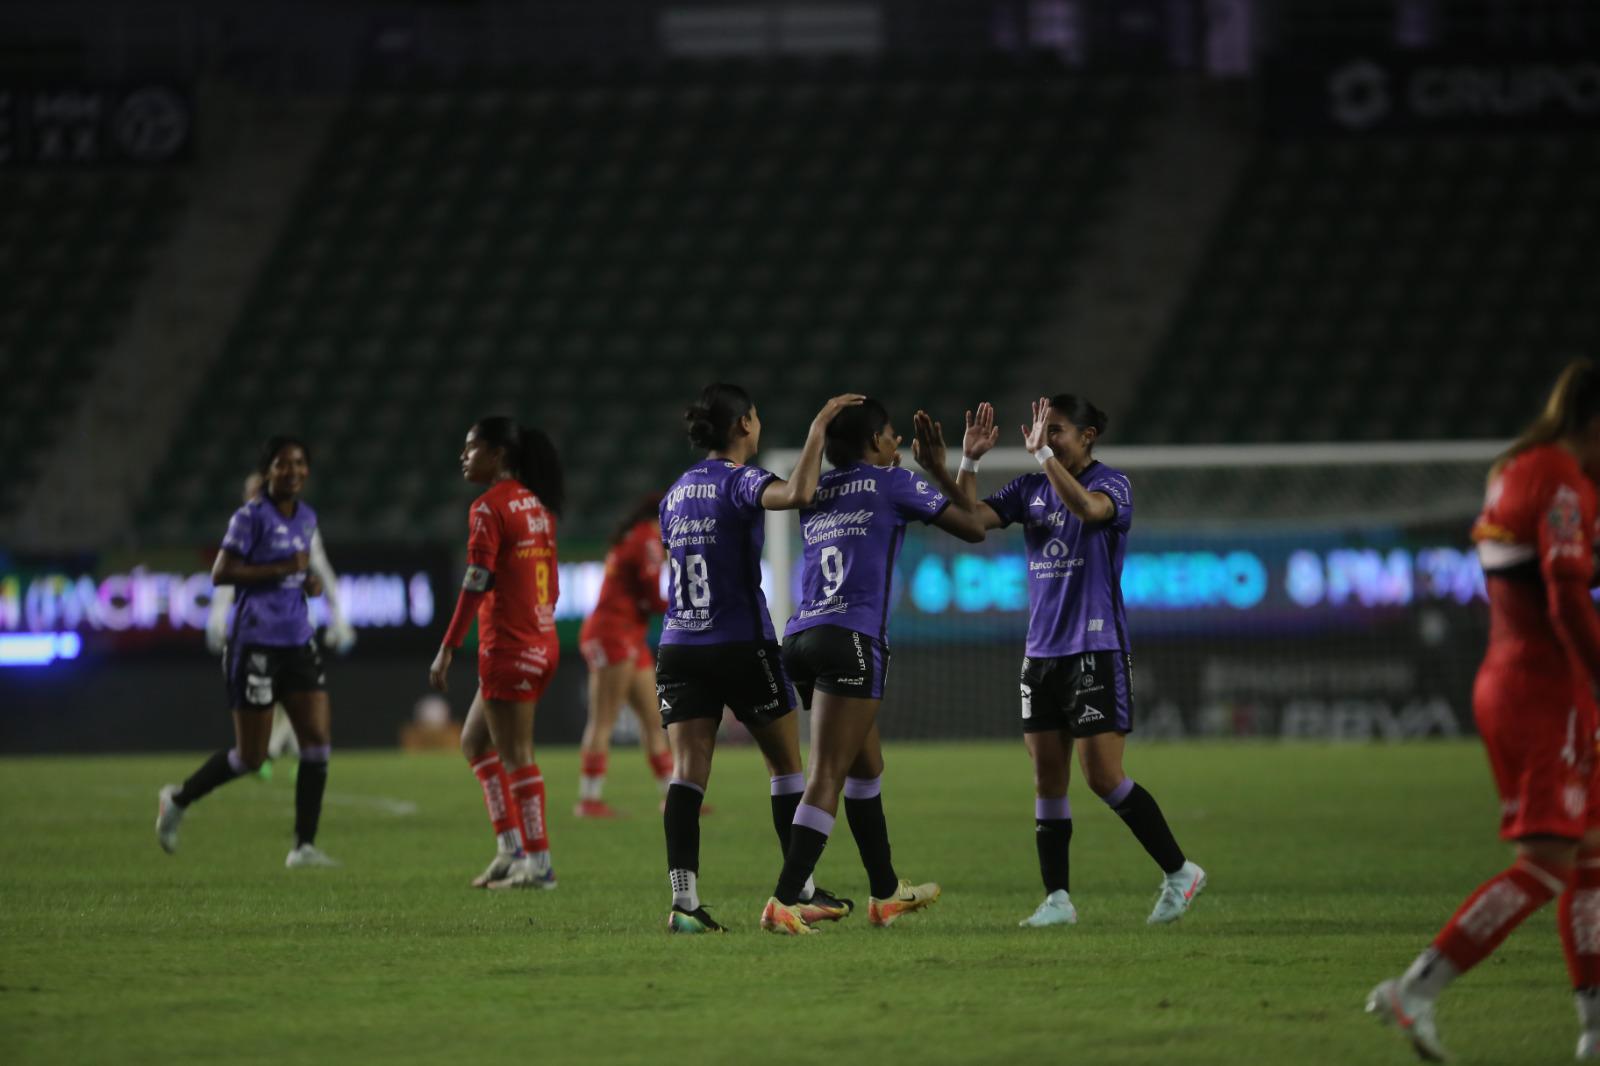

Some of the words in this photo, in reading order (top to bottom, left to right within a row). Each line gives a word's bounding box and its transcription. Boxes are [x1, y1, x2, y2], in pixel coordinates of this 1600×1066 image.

[808, 527, 867, 545] caliente.mx
[671, 554, 711, 610] 18
[820, 545, 844, 598] 9
[1030, 561, 1053, 571] Banco
